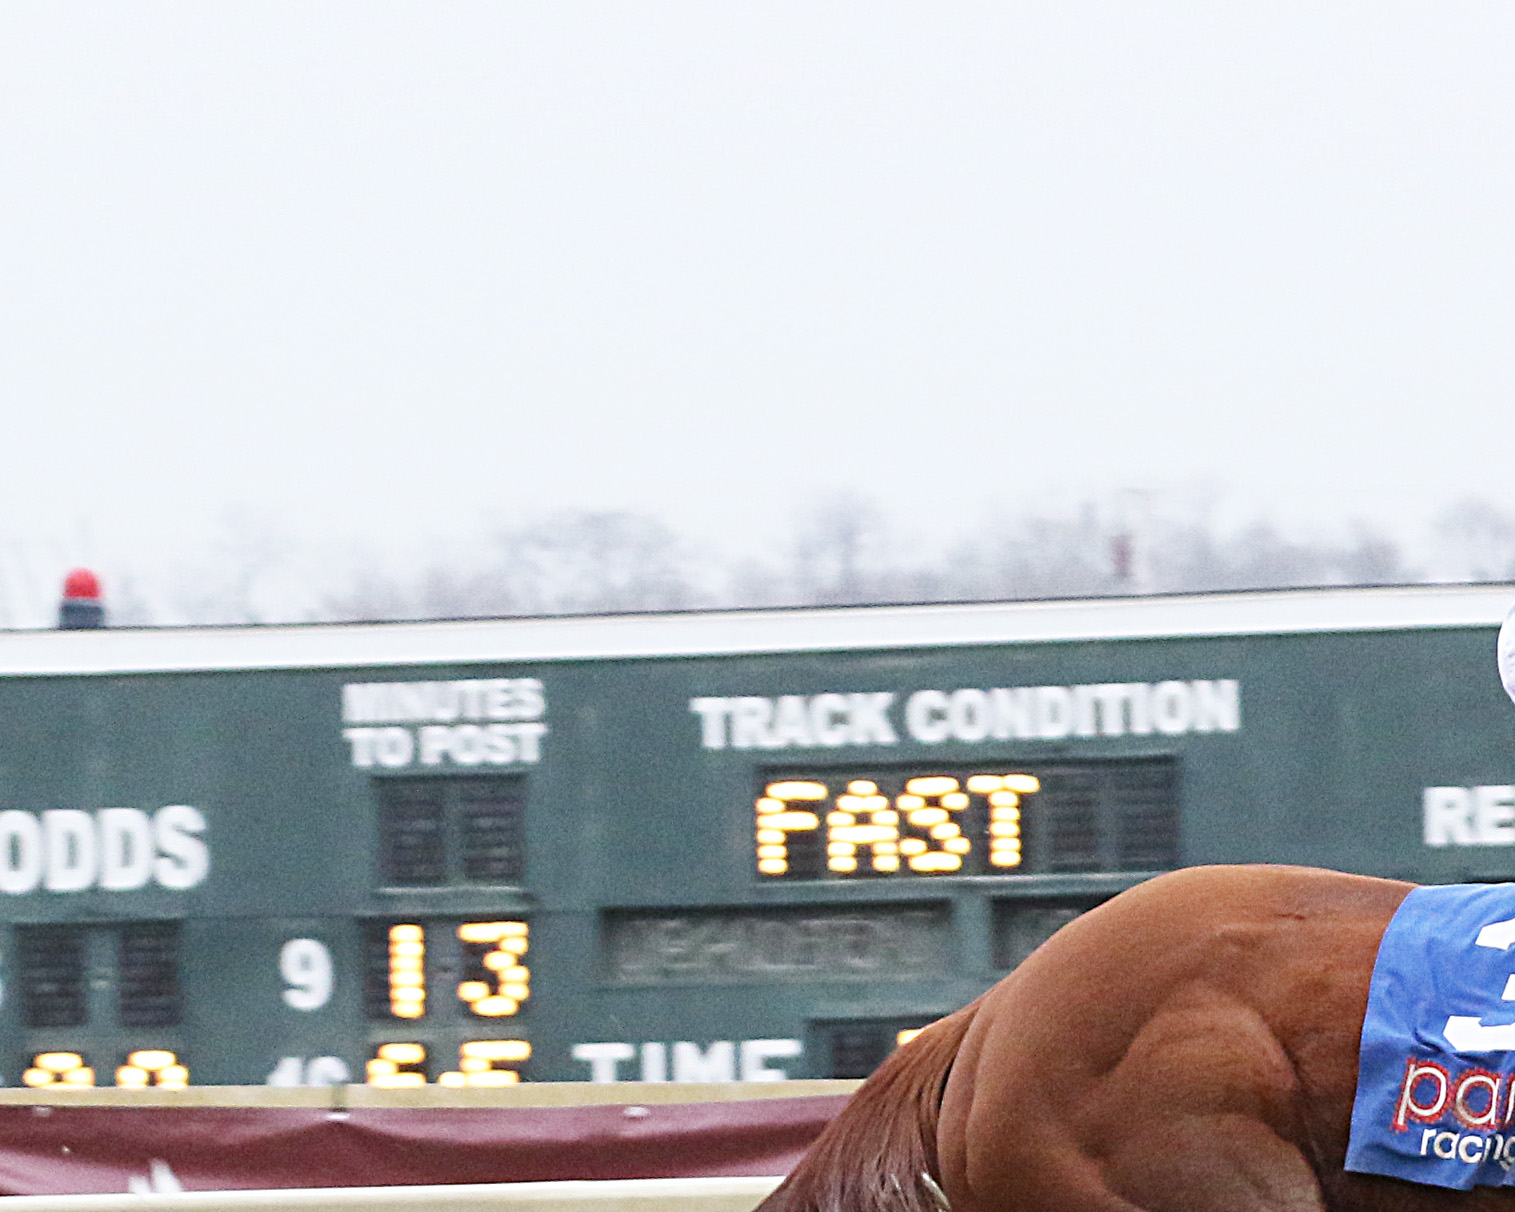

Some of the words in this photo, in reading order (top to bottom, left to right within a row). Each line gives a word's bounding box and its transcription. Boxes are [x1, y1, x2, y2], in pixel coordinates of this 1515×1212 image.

[341, 677, 547, 724] MINUTES
[690, 691, 899, 750] TRACK
[903, 678, 1241, 740] CONDITION
[341, 726, 413, 768] TO
[419, 723, 549, 766] POST
[0, 804, 211, 894] ODDS
[756, 773, 1041, 876] FAST
[279, 936, 335, 1012] 9
[387, 921, 532, 1019] 13
[572, 1039, 801, 1083] TIME
